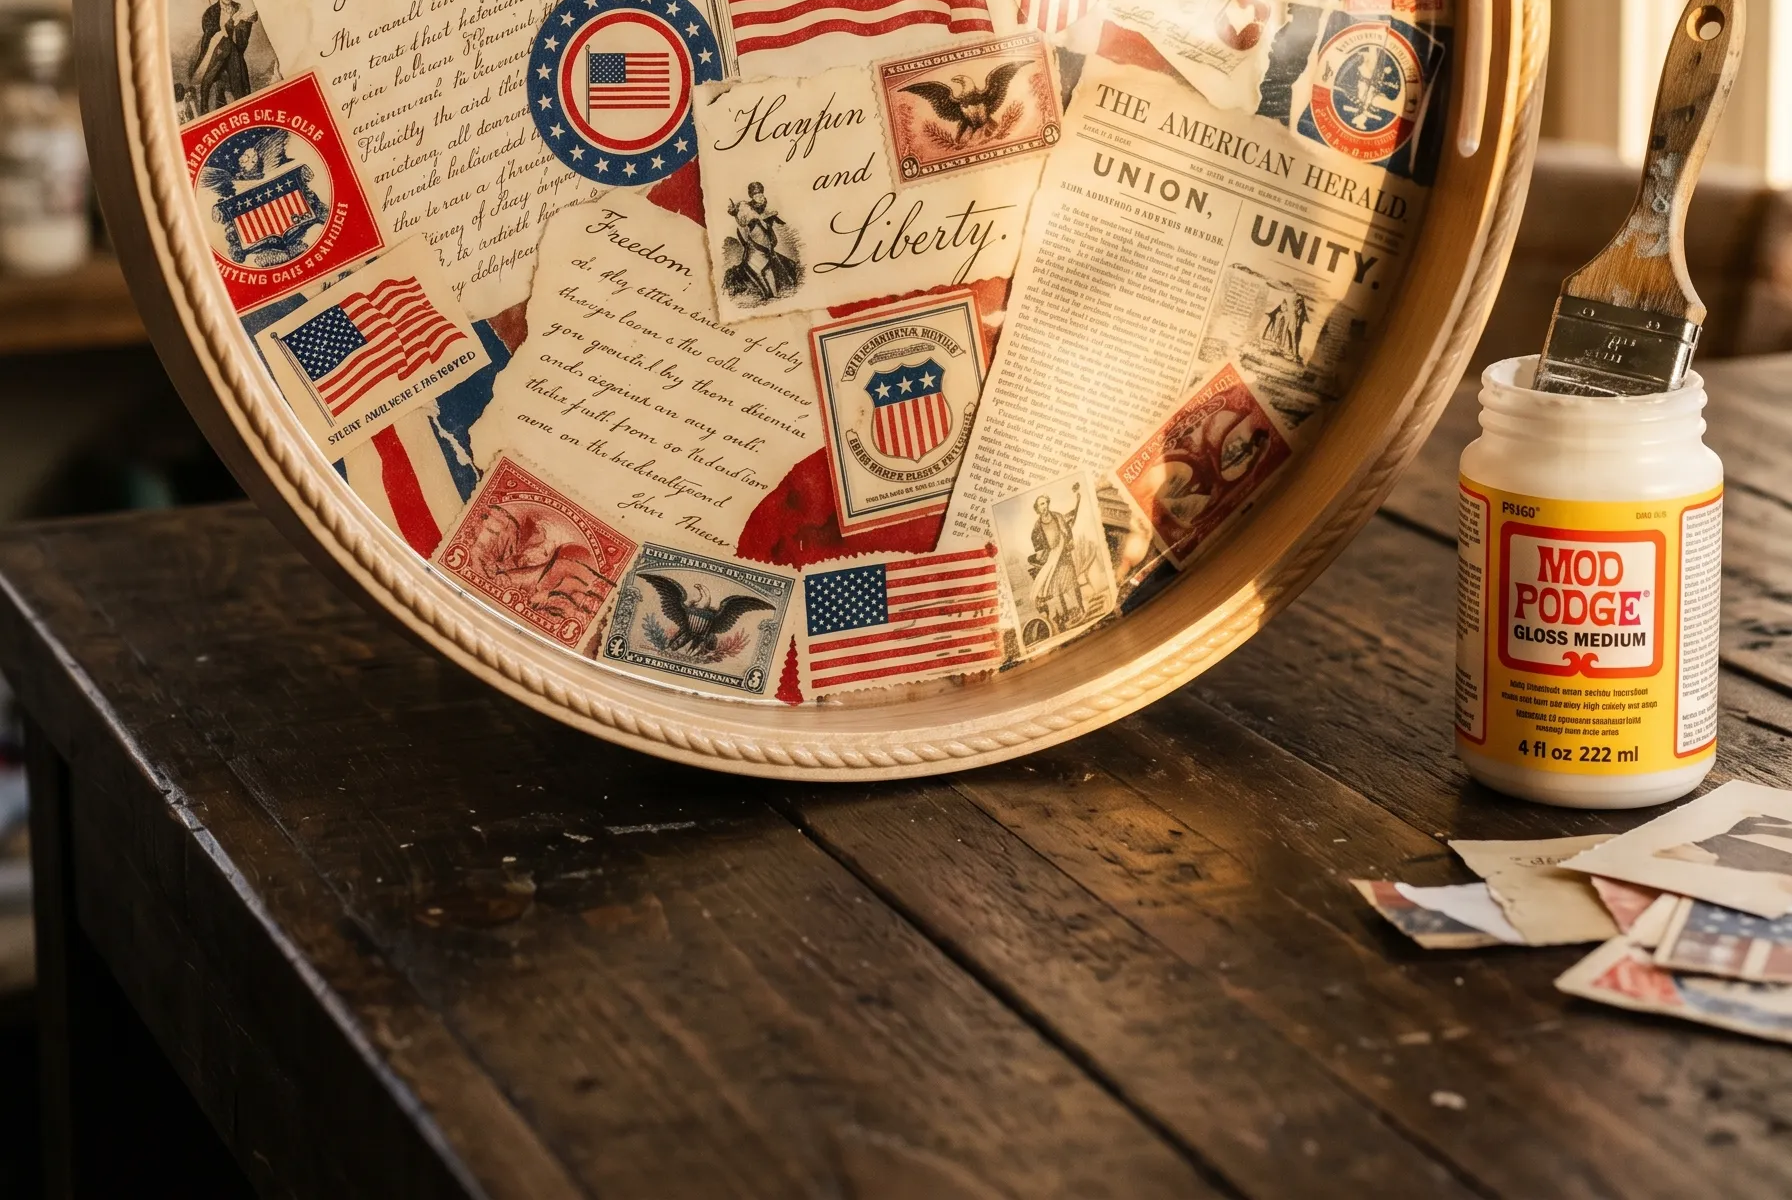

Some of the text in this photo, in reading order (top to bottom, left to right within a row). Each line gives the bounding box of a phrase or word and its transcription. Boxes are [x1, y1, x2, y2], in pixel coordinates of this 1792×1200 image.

[1095, 83, 1151, 124] THE
[1158, 111, 1296, 179] AMERICAN
[812, 152, 875, 191] and
[1093, 152, 1213, 219] UNION,
[585, 208, 693, 277] Freedom
[813, 192, 1017, 285] Liberty.
[1250, 214, 1380, 290] UNITY.
[1537, 545, 1624, 587] MOD
[1514, 582, 1642, 627] PODGE
[1514, 624, 1647, 648] GLOSS MEDIUM
[1518, 740, 1639, 762] 4 fl oz 222 ml
